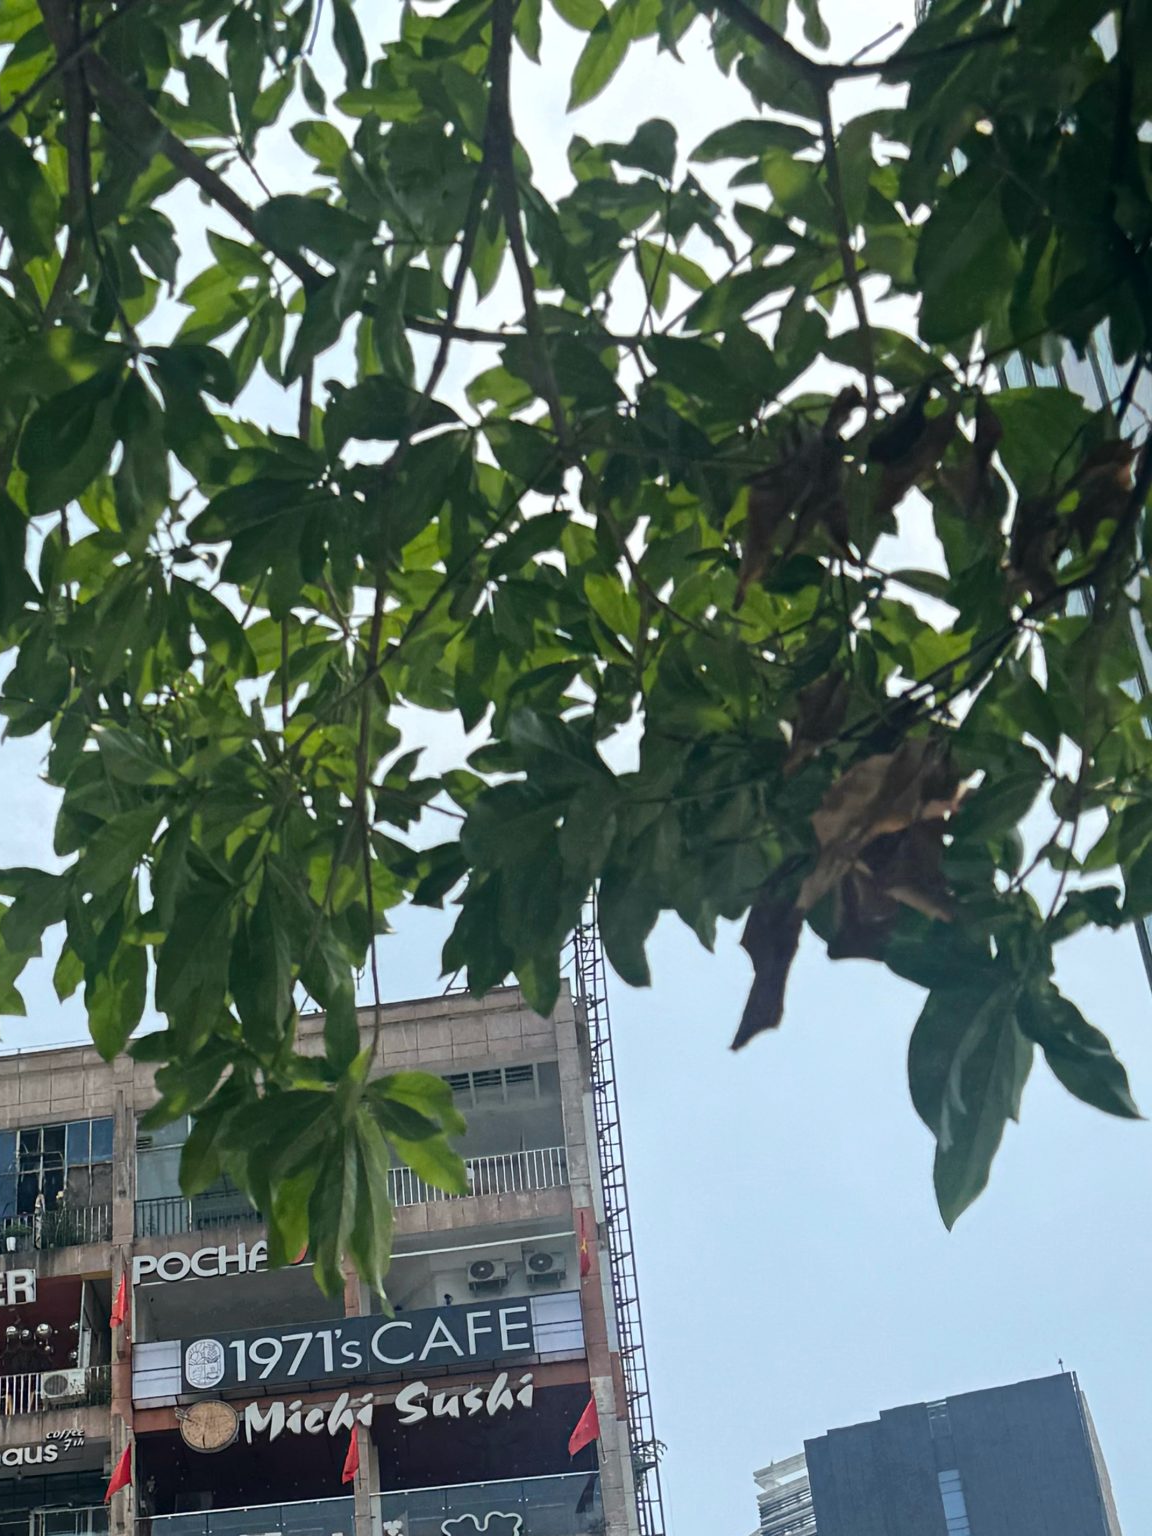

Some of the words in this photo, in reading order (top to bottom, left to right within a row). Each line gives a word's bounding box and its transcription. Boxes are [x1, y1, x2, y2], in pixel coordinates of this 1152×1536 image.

[370, 1305, 531, 1366] CAFE
[244, 1391, 374, 1446] Michi
[394, 1372, 535, 1426] Sushi
